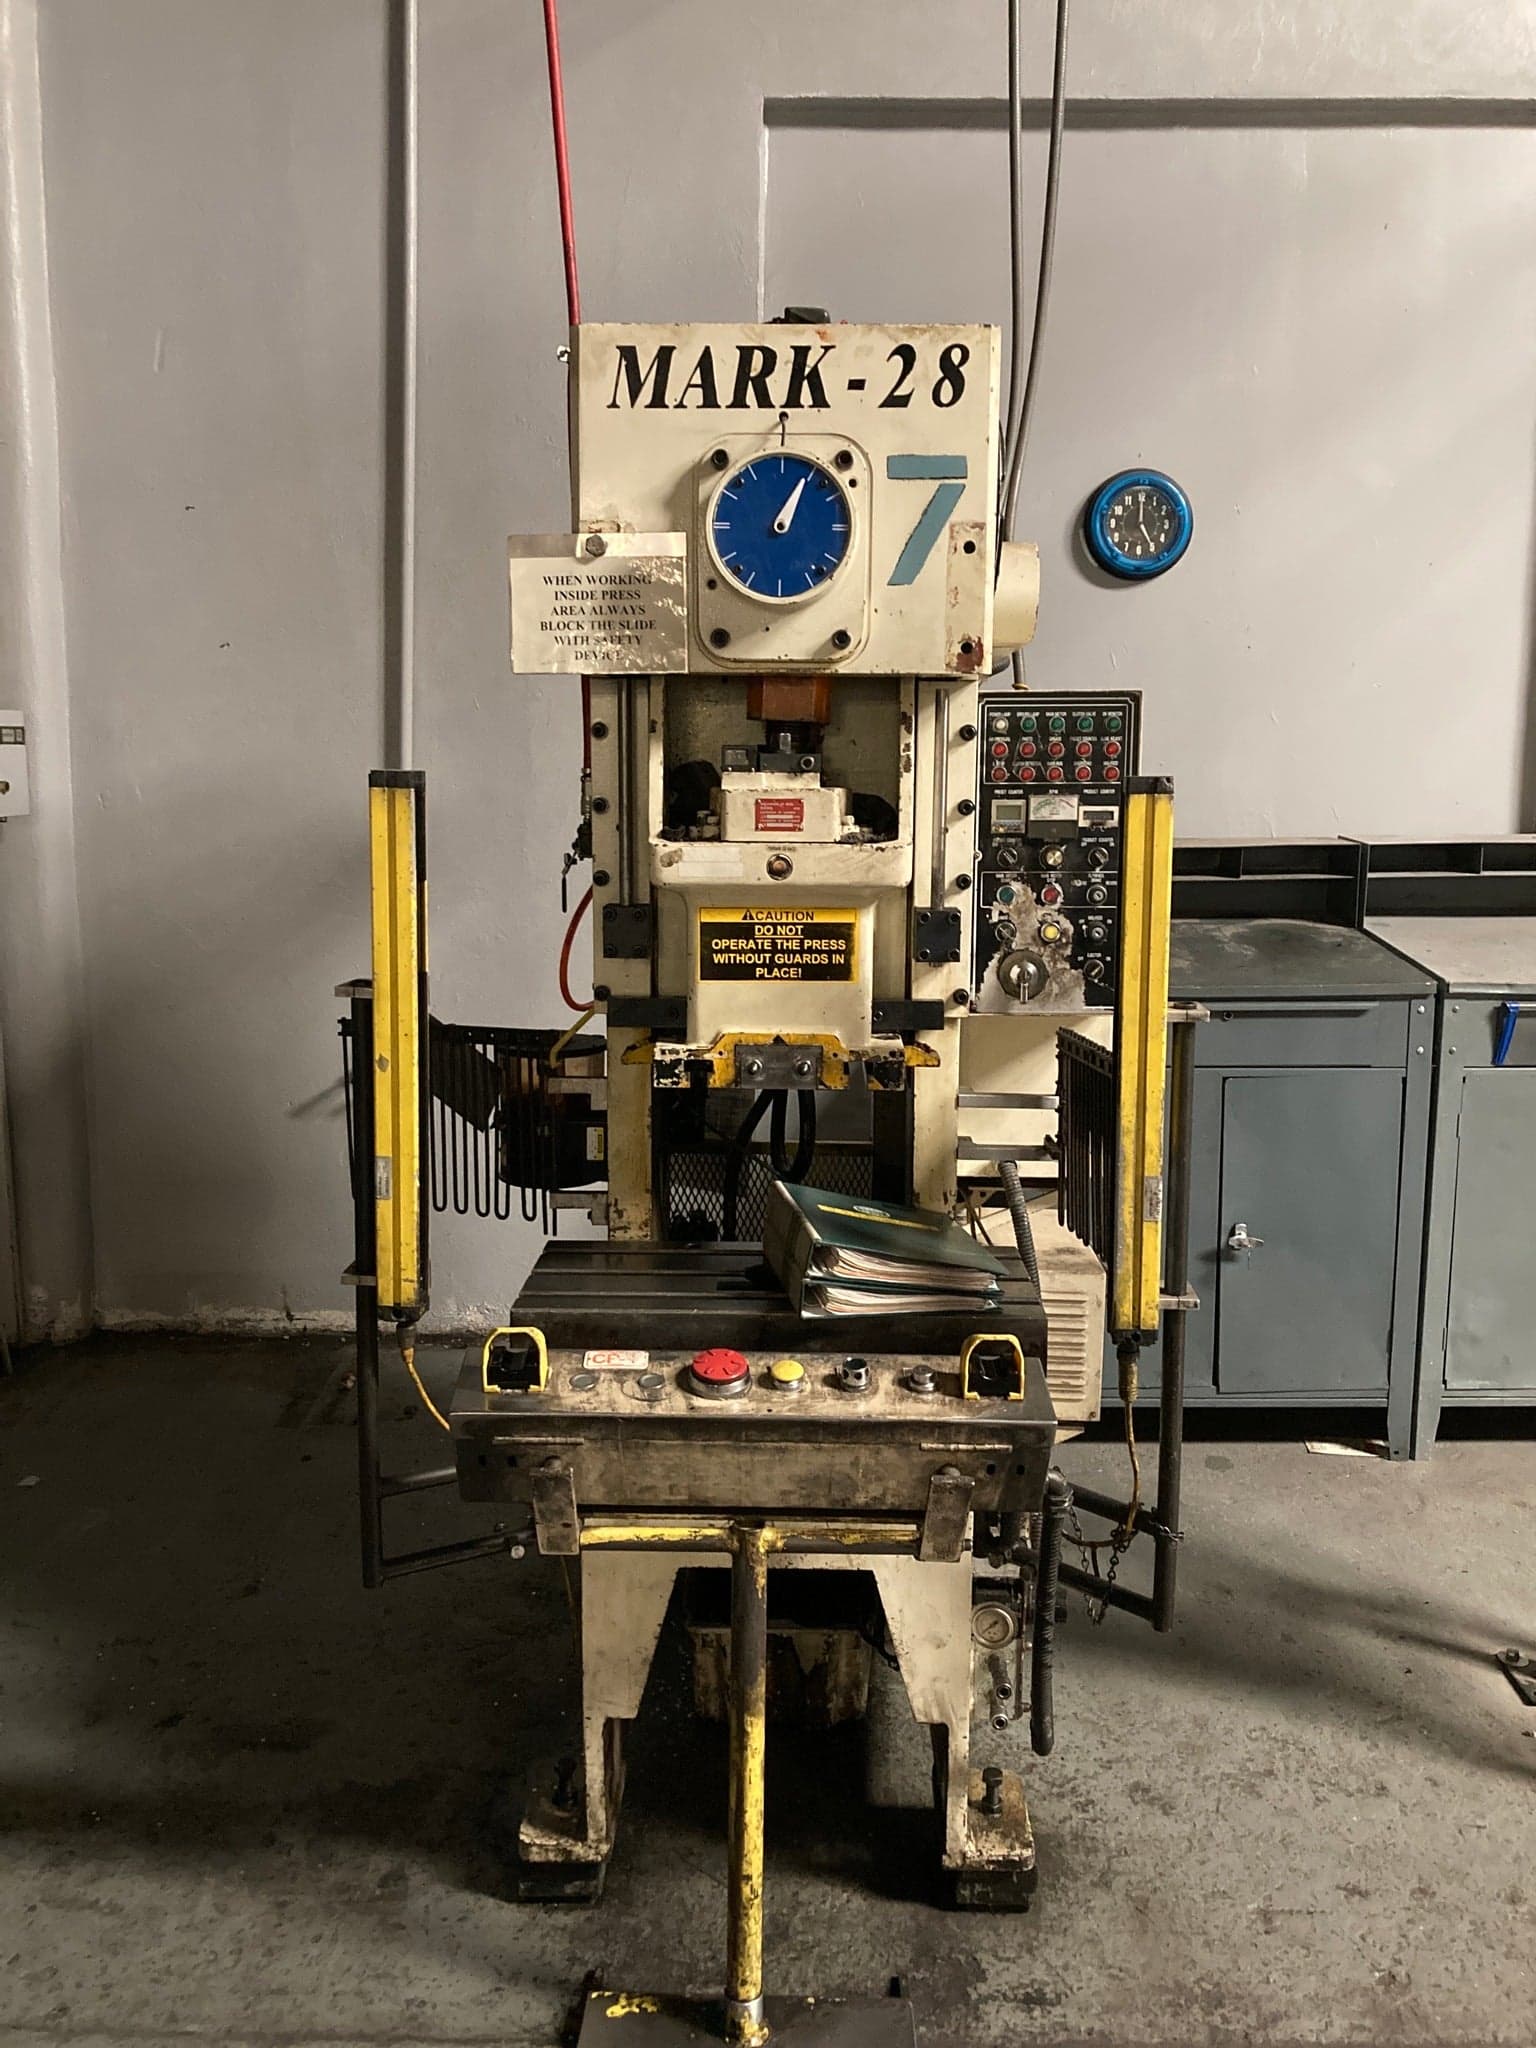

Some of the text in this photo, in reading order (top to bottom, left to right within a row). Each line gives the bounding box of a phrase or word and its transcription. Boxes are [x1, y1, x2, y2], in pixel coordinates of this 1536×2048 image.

[1125, 495, 1132, 506] 11
[1138, 493, 1146, 502] 12
[1114, 505, 1123, 515] 10
[1161, 505, 1167, 515] 2
[886, 454, 968, 587] 7
[1110, 518, 1116, 529] 9
[1164, 519, 1170, 529] 3
[1160, 533, 1165, 543] 4
[1124, 542, 1129, 552] 7
[1136, 545, 1142, 555] 6
[543, 574, 652, 586] WHEN WORKING
[554, 590, 641, 601] INSIDE PRESS
[551, 605, 646, 616] AREA ALWAYS
[540, 620, 657, 632] BLOCK THE SLIDE
[553, 634, 643, 646] WITH SAFETY
[574, 649, 624, 661] DEVICE
[755, 911, 815, 921] CAUTION
[755, 925, 804, 936] DO NOT
[711, 939, 847, 950] OPERATE THE PRESS
[712, 953, 845, 964] WITHOUT GUARDS IN
[755, 967, 803, 978] PLACE!
